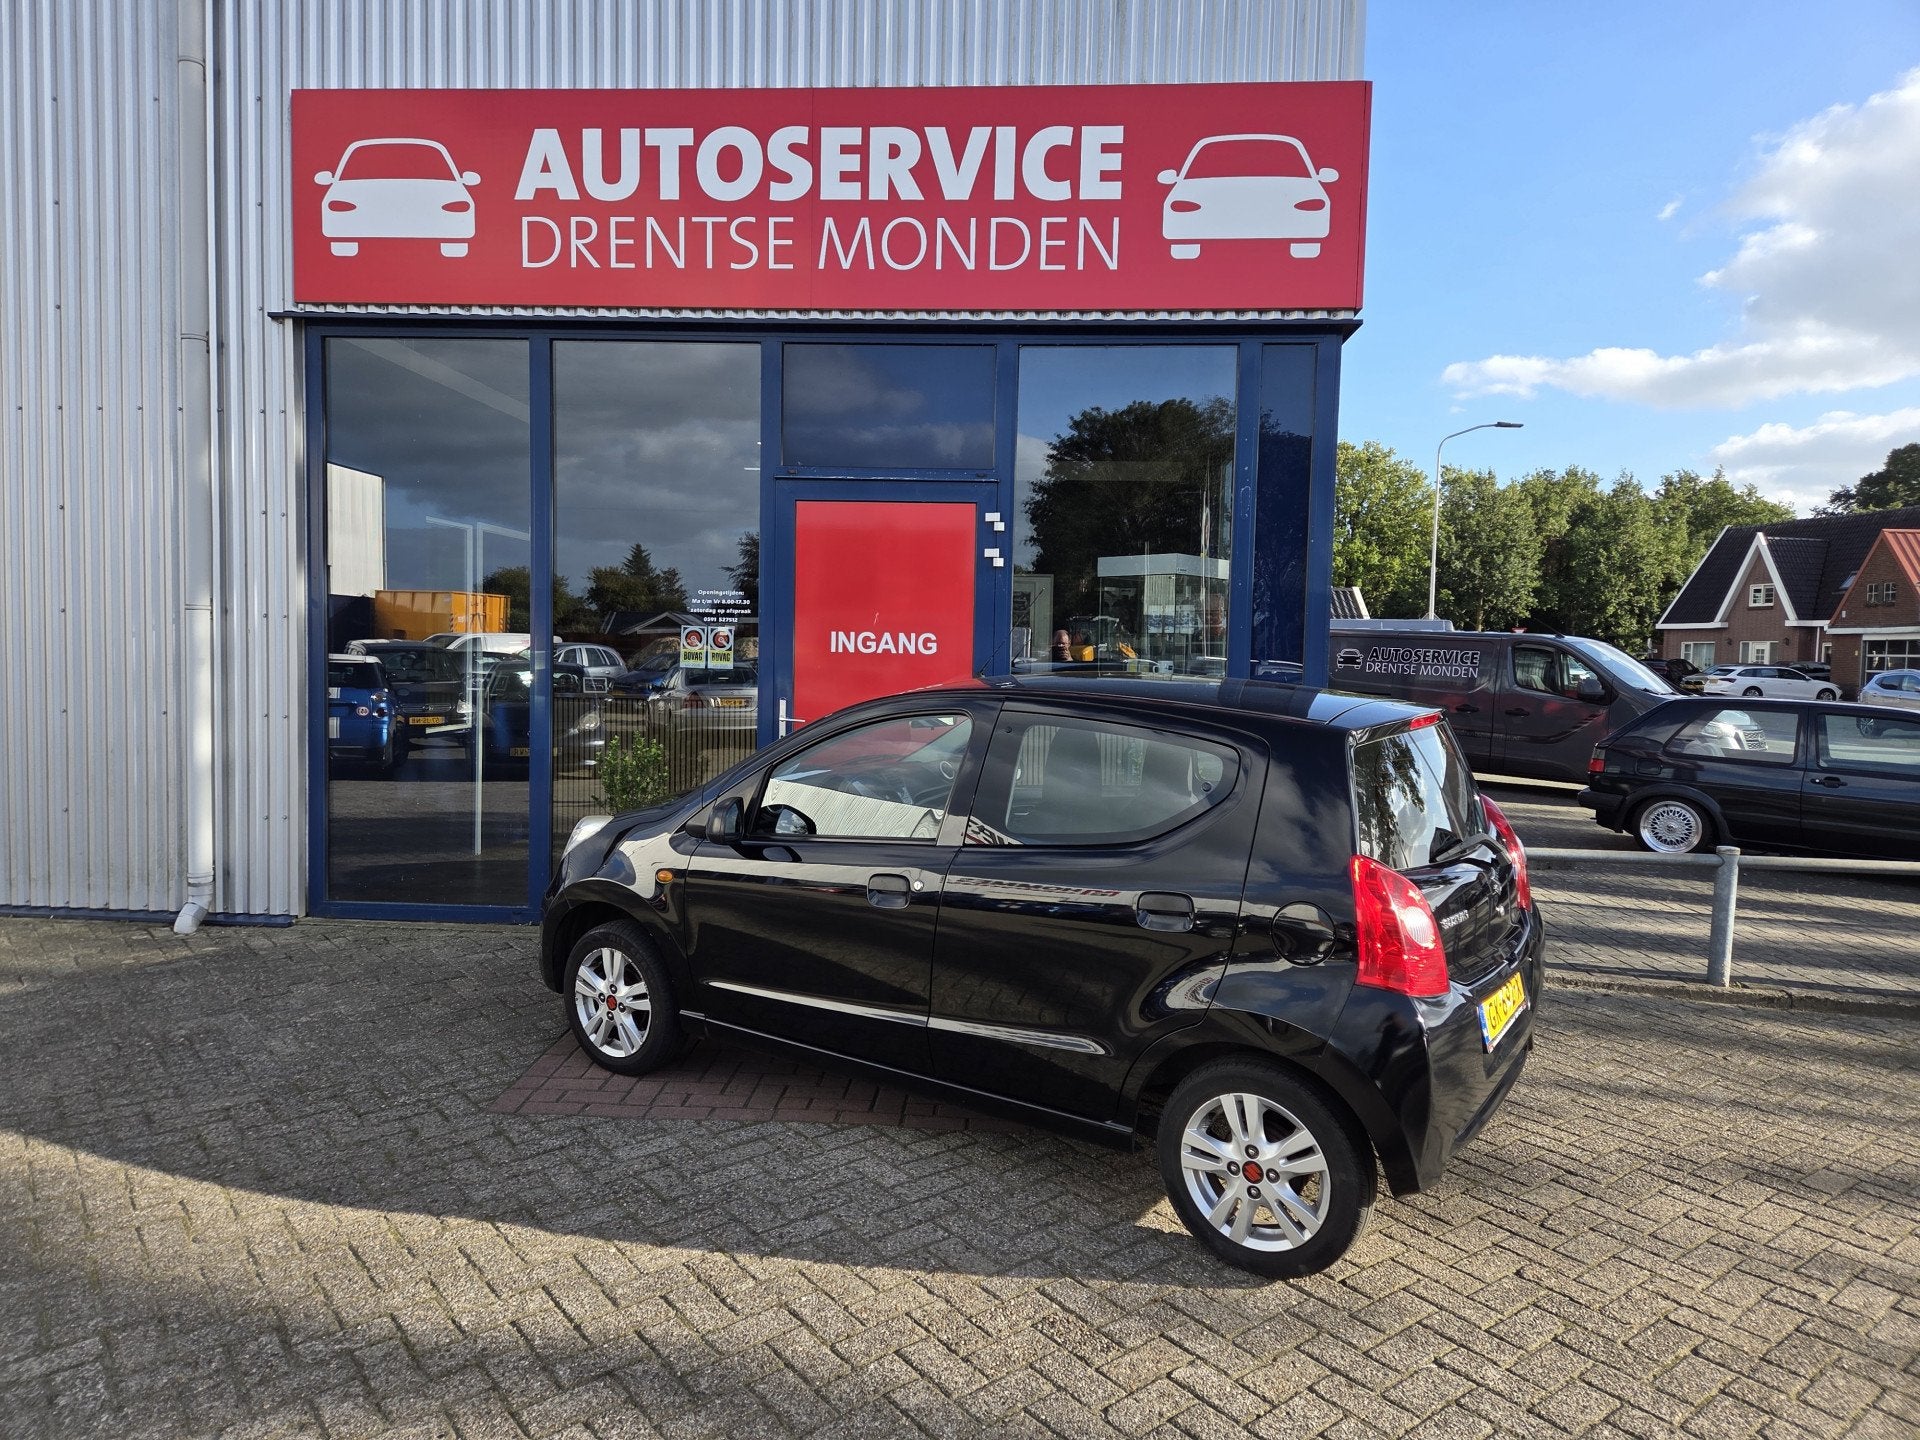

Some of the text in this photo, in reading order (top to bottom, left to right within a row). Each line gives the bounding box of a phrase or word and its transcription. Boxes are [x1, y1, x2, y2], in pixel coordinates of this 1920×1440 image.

[514, 125, 1124, 202] AUTOSERVICE
[520, 215, 1120, 271] DRENTSE MONDEN
[829, 630, 938, 655] INGANG
[683, 651, 703, 661] BOVAG
[711, 652, 731, 662] BOVAG
[1368, 646, 1480, 666] AUTOSERVICE
[1365, 662, 1479, 678] DRENTSE MONDEN
